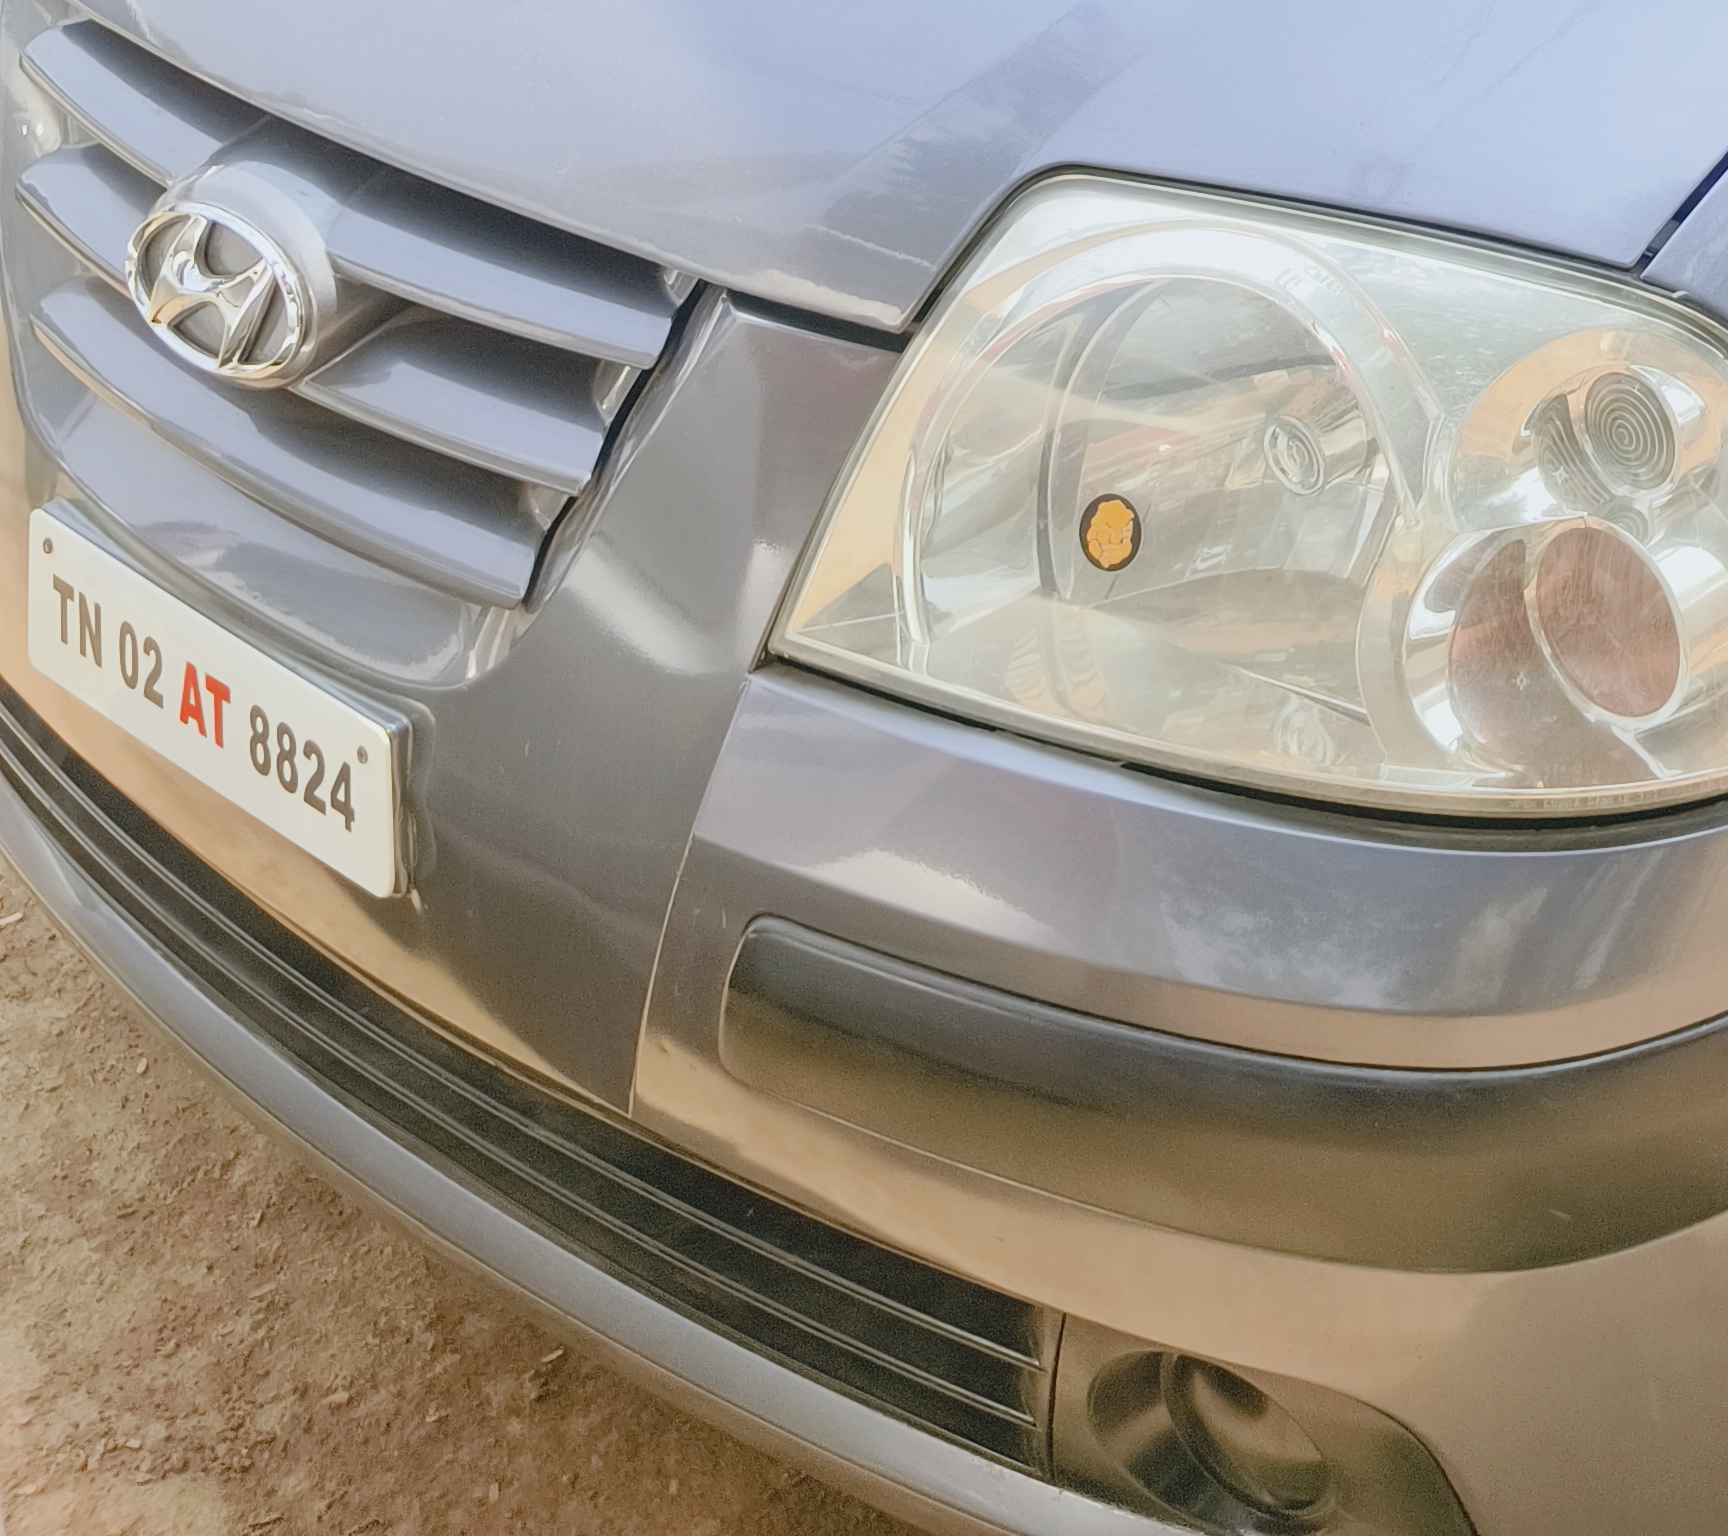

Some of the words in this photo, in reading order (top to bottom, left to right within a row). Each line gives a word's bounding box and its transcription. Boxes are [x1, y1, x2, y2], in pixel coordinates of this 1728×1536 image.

[52, 573, 103, 668] TN
[118, 620, 164, 710] 02
[178, 660, 232, 750] AT
[248, 704, 356, 833] 8824
